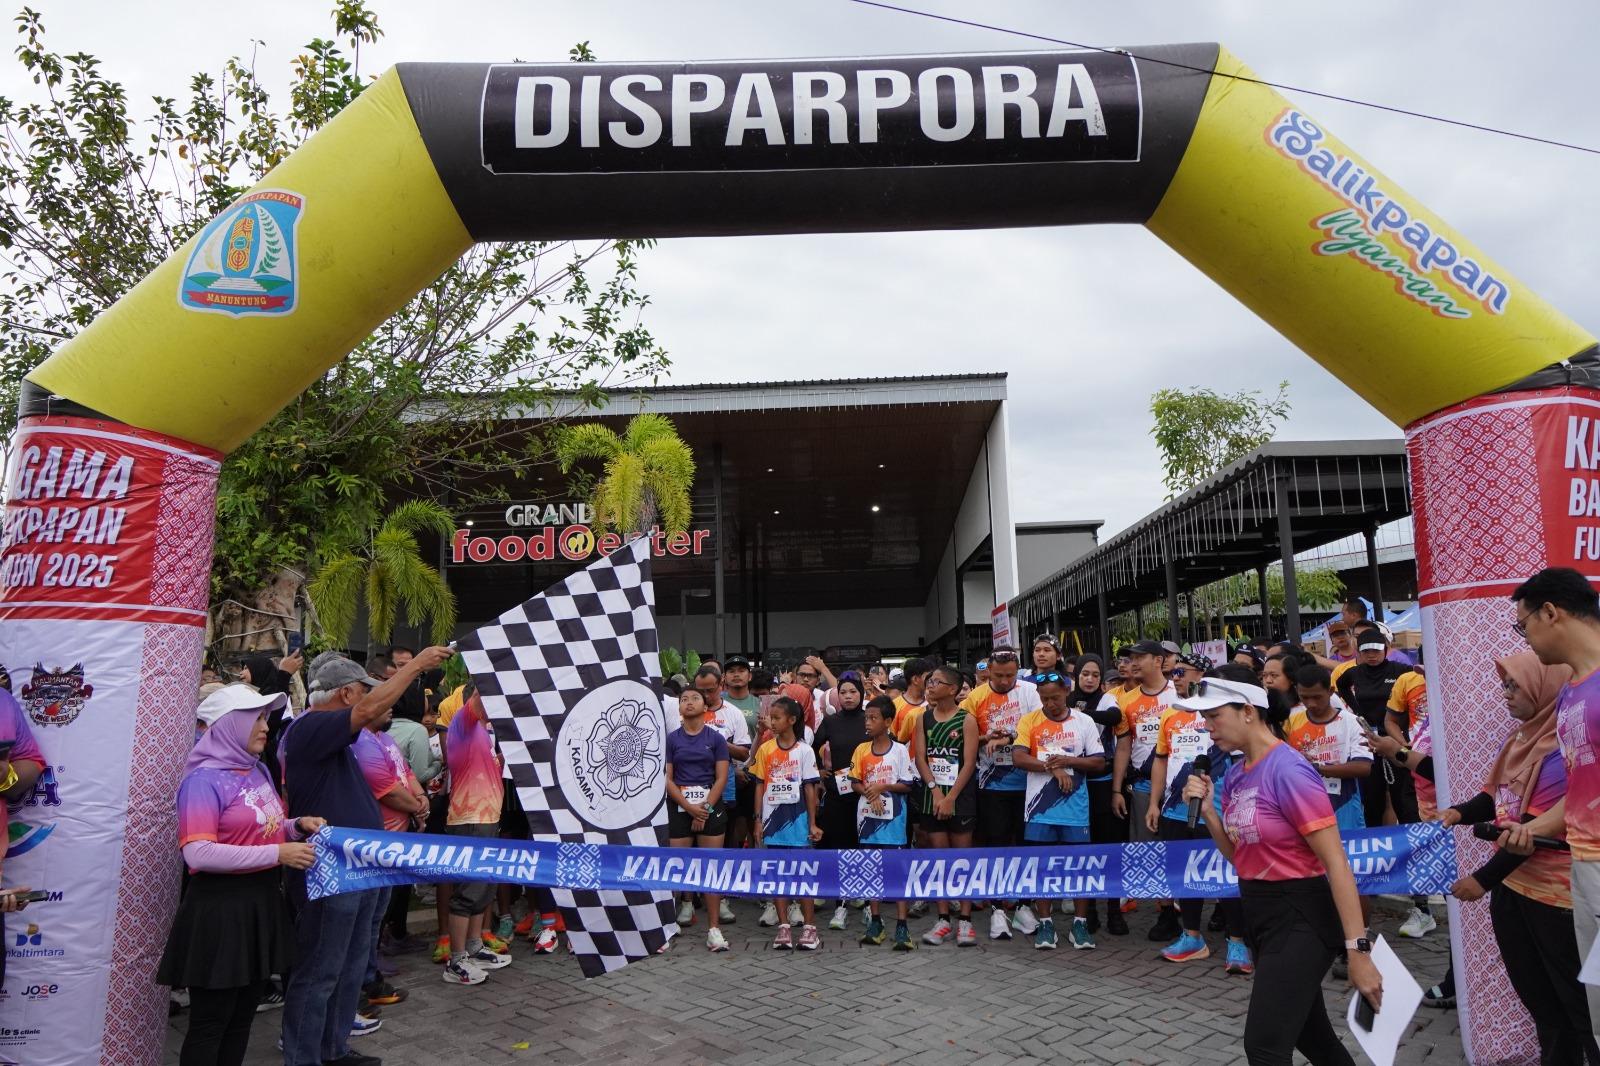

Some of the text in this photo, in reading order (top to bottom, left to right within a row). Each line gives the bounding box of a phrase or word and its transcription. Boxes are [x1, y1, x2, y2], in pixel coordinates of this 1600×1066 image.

[514, 62, 1108, 149] DISPARPORA
[1267, 109, 1509, 314] Balikpapan
[206, 292, 268, 306] MANUNTUNG
[15, 445, 135, 499] GAMA
[451, 526, 555, 563] food
[43, 553, 119, 587] 2025
[1177, 735, 1201, 743] 2550
[571, 746, 595, 803] KAGAMA
[685, 791, 705, 799] 2135
[771, 784, 793, 792] 2556
[1341, 836, 1393, 855] UN
[479, 847, 540, 865] FUN
[622, 855, 820, 893] KAGAMA FUN
[1347, 857, 1397, 875] UN
[904, 855, 1108, 898] KAGAMA FUN
[1042, 875, 1106, 893] RUN
[756, 881, 820, 896] RUN
